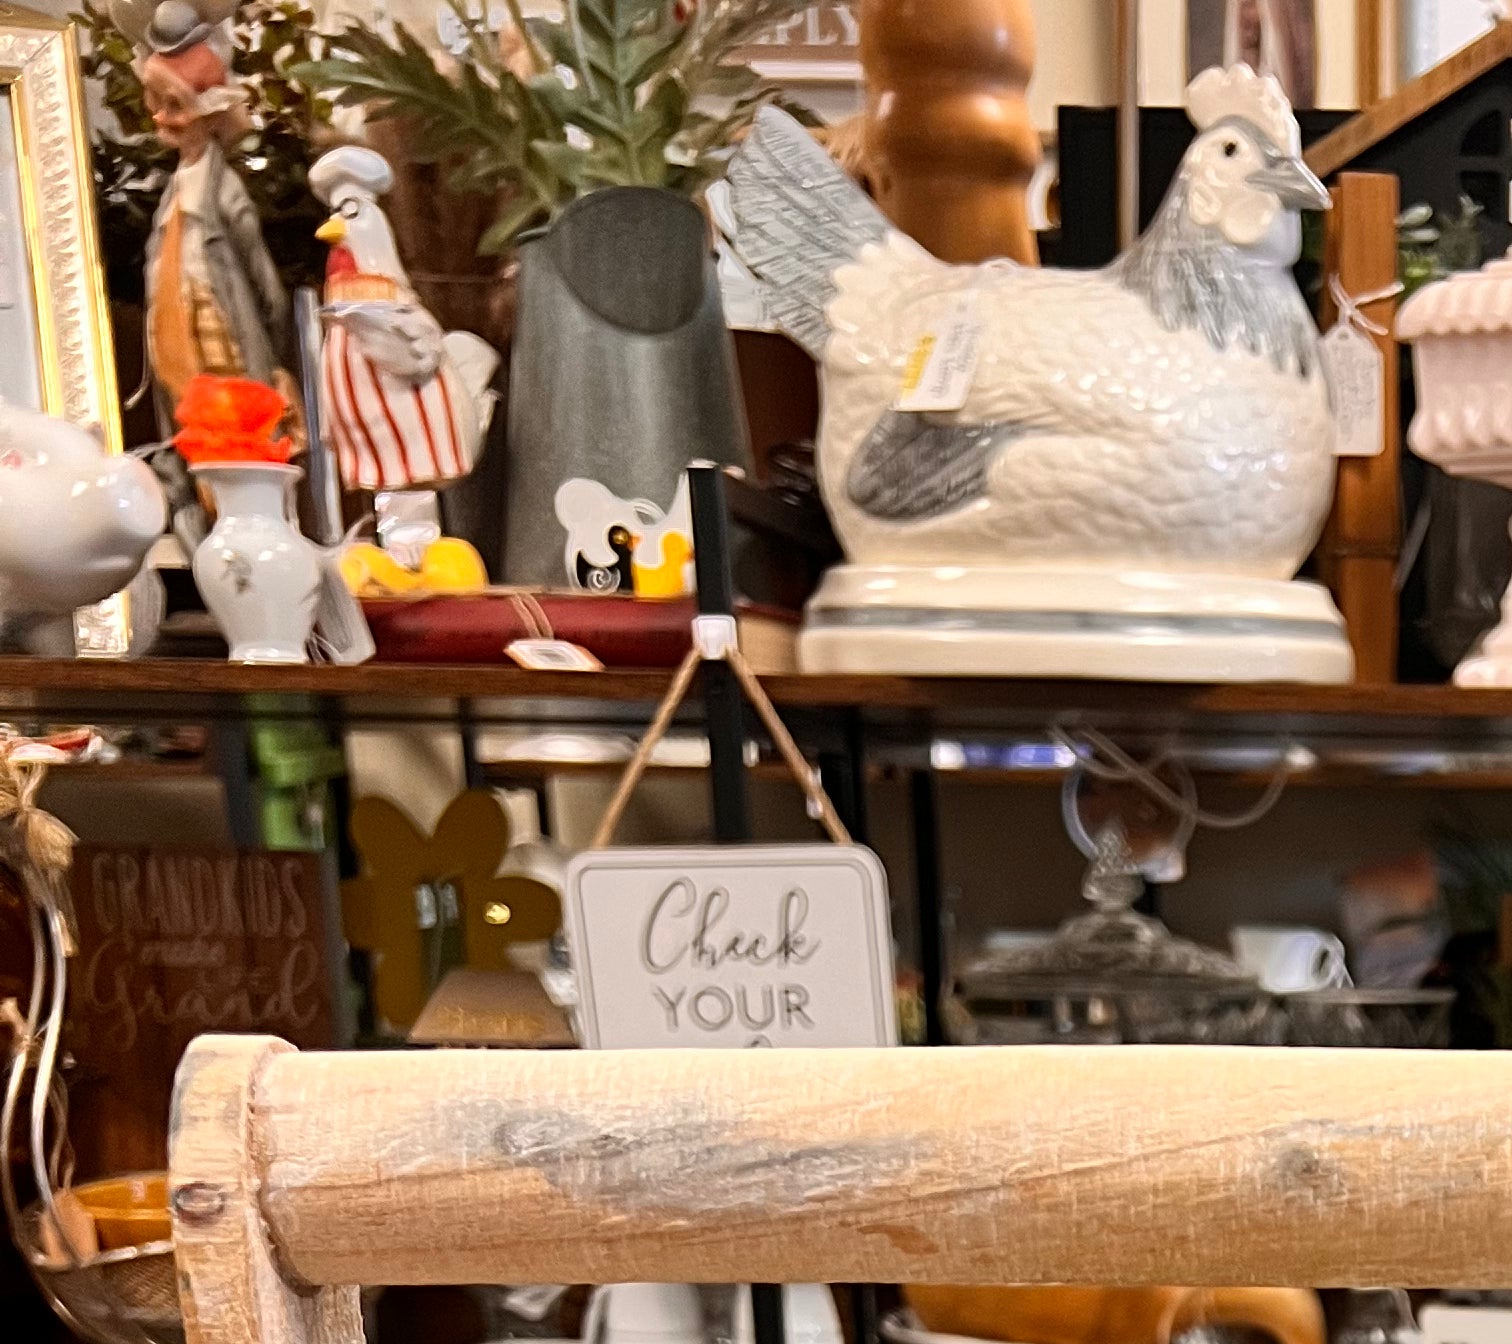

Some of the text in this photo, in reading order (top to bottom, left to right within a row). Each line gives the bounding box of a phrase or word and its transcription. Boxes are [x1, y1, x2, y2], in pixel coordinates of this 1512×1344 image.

[758, 5, 862, 46] PLY
[640, 876, 822, 975] Check
[651, 983, 817, 1033] YOUR
